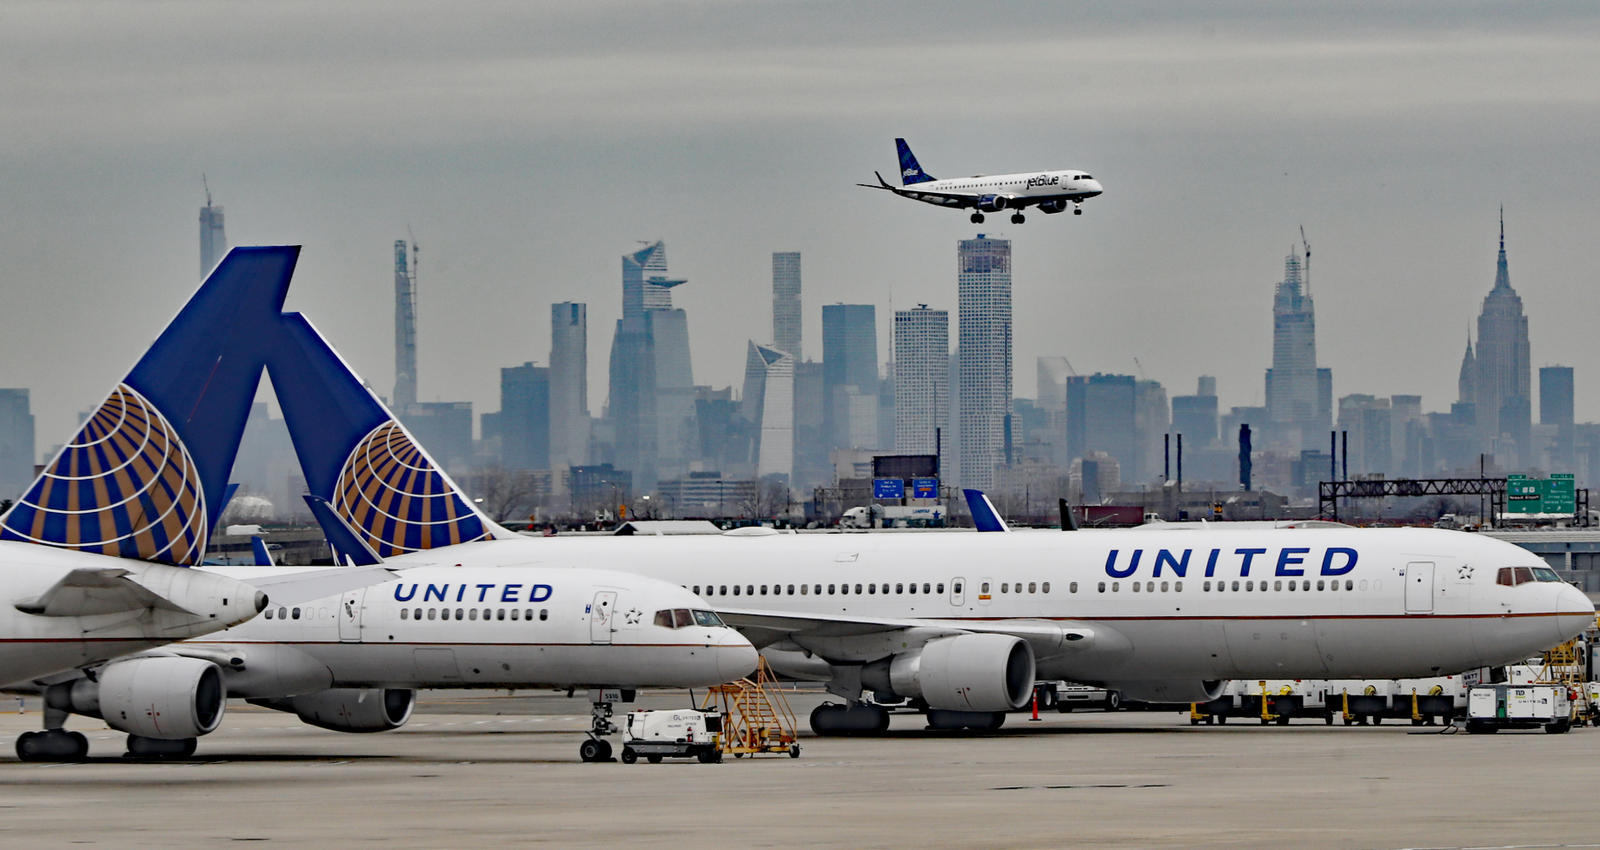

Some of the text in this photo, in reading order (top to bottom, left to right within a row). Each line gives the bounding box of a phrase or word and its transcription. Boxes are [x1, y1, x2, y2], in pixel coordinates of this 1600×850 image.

[1026, 174, 1059, 190] jetBlue
[1105, 547, 1359, 578] UNITED
[394, 583, 553, 603] UNITED
